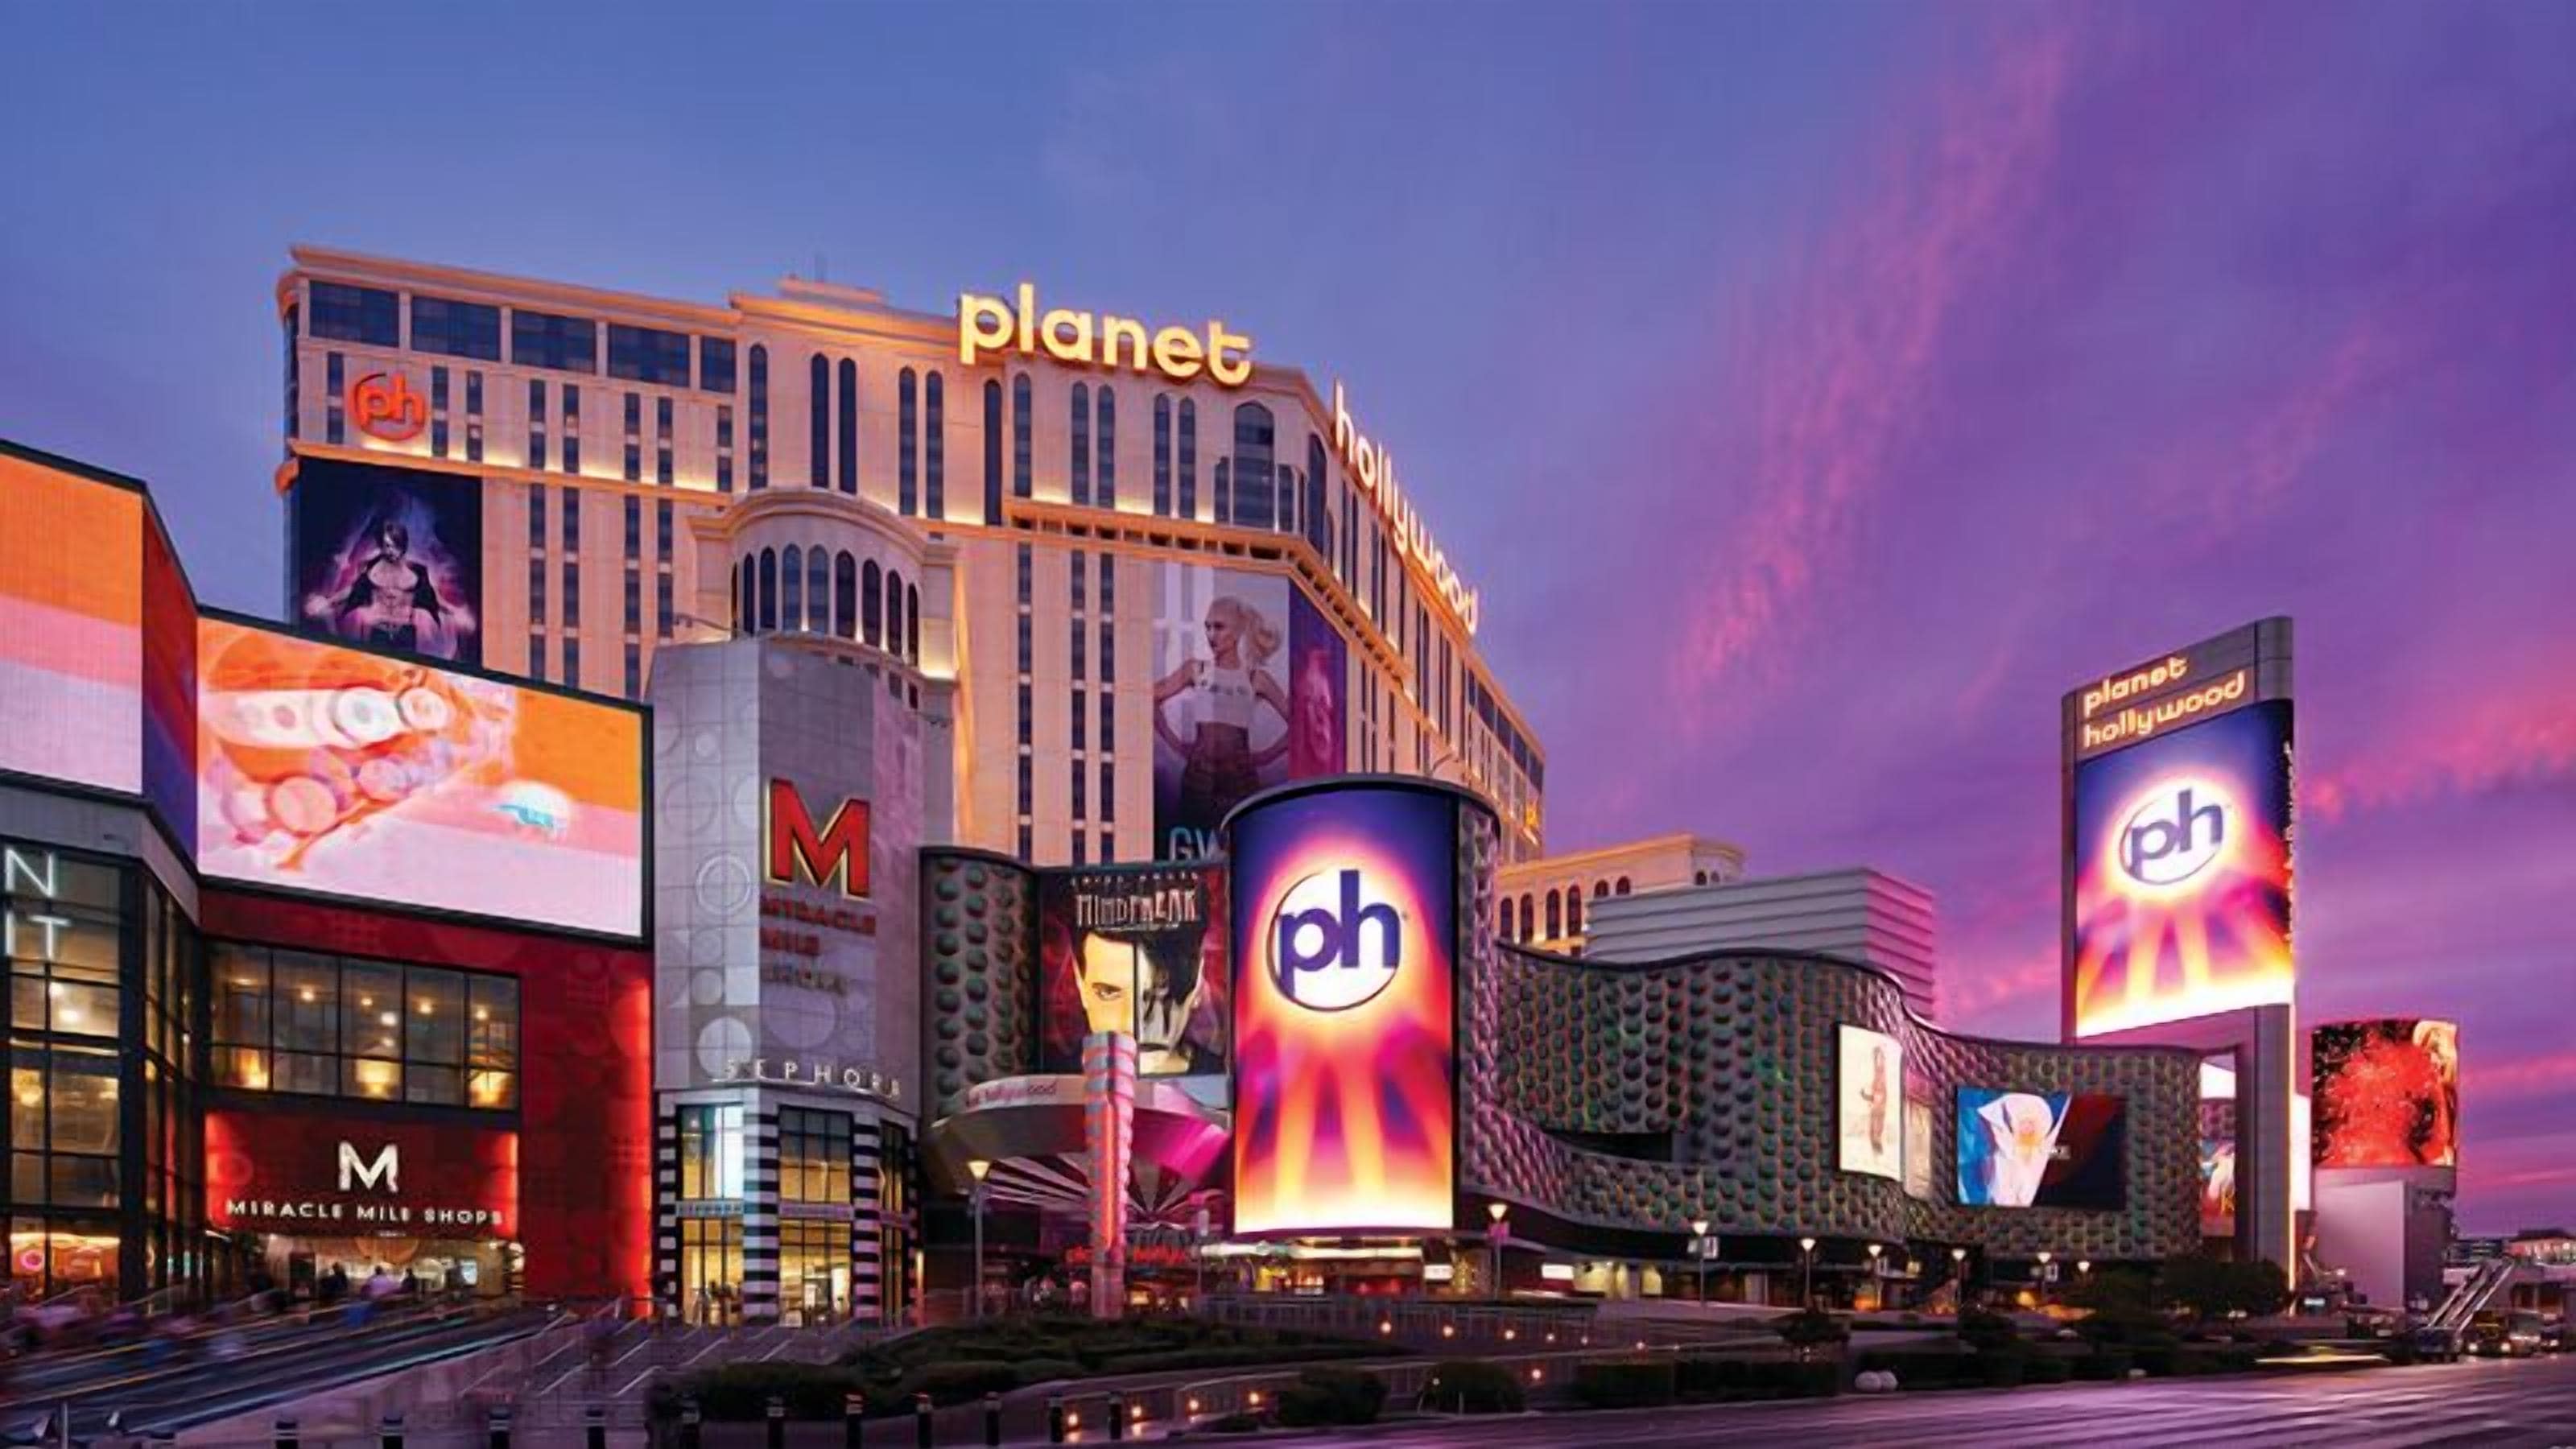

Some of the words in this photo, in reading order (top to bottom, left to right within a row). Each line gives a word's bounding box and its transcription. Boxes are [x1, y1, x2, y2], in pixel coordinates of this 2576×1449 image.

[959, 283, 1252, 386] planet
[359, 373, 426, 431] ph
[1334, 380, 1479, 635] hollywood
[2083, 657, 2188, 719] planet
[2083, 671, 2245, 749] hollywood
[766, 778, 871, 902] M
[2130, 787, 2223, 881] ph
[1280, 869, 1402, 1000] ph
[725, 1058, 901, 1101] SEPHORA
[338, 1141, 398, 1193] M
[227, 1198, 343, 1219] MIRACLE
[357, 1204, 411, 1222] MILE
[423, 1208, 503, 1225] SHOPS
